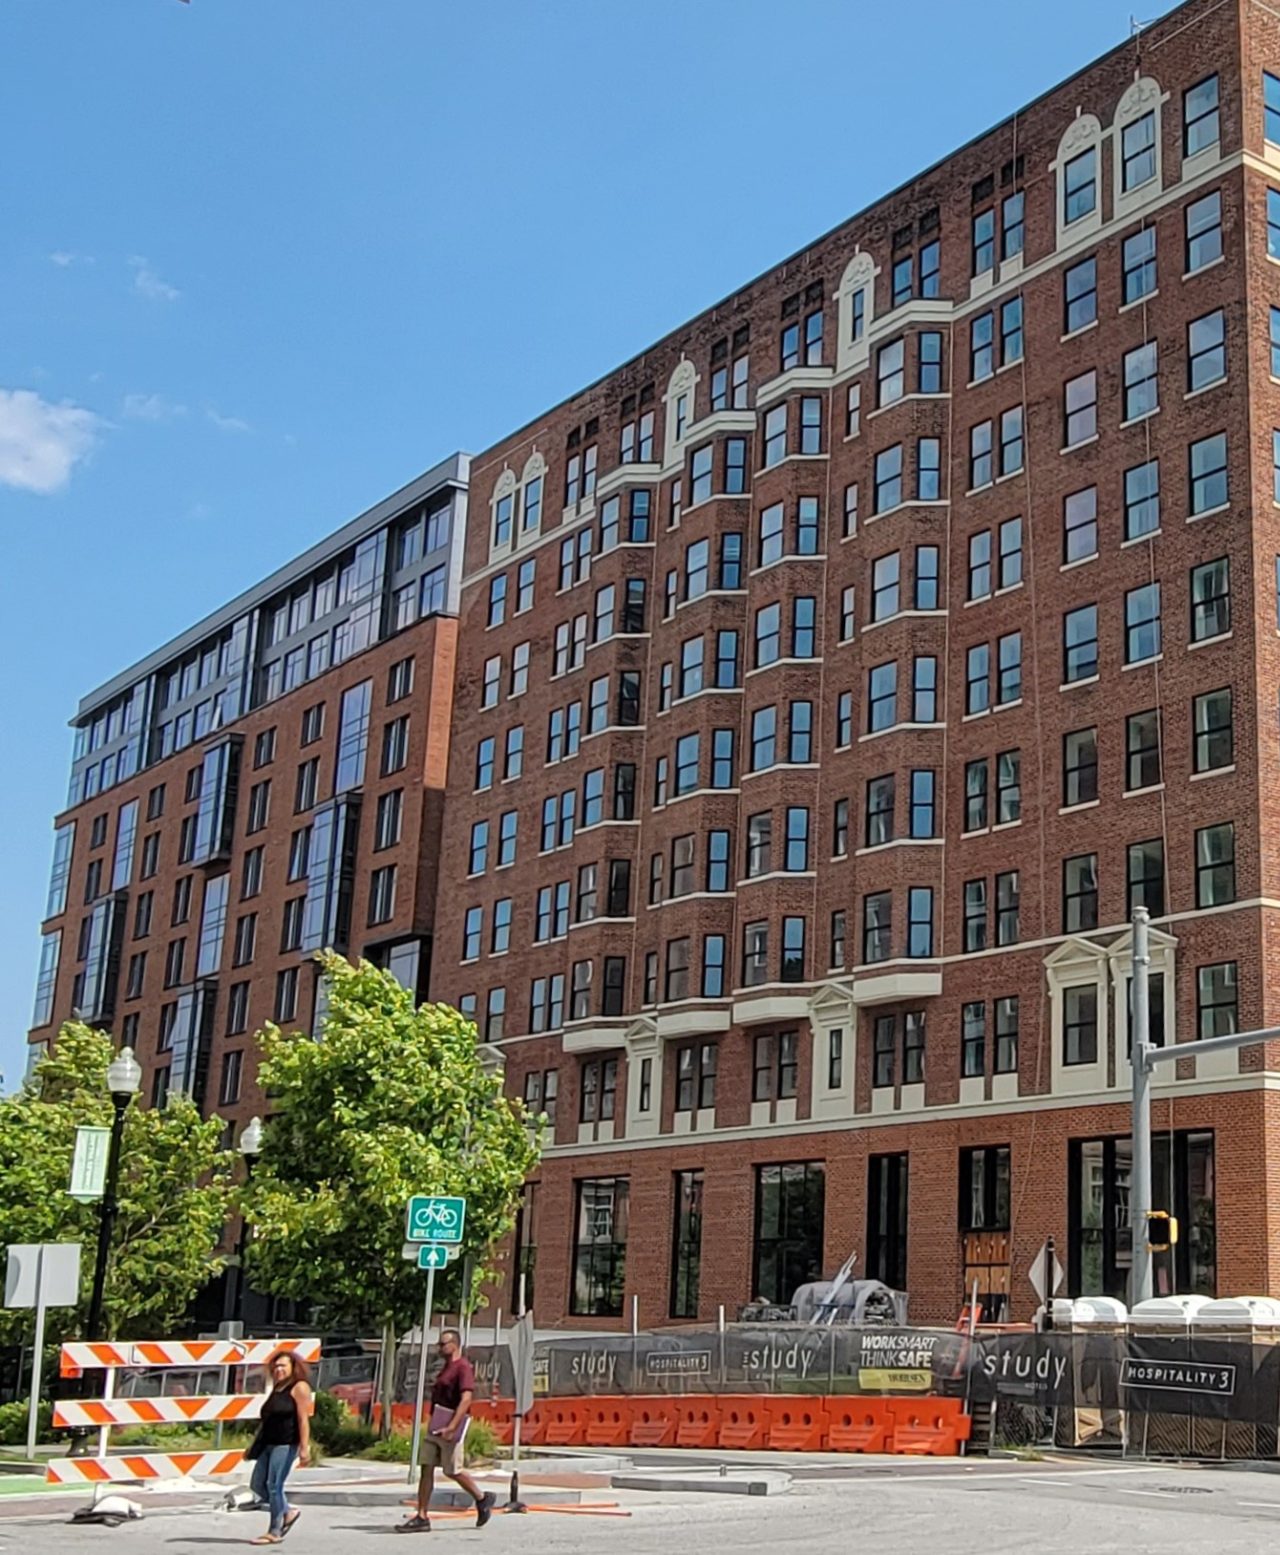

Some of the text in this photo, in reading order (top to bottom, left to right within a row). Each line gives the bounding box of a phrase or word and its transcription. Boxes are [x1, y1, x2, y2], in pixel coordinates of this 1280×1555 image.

[412, 1228, 457, 1239] BIKE ROUTE
[469, 1358, 501, 1386] tudy
[571, 1347, 617, 1385] study
[649, 1354, 708, 1370] HOSPITALITY 3
[750, 1342, 812, 1379] study
[983, 1348, 1067, 1390] study
[1127, 1366, 1230, 1389] HOSPITALITY 3
